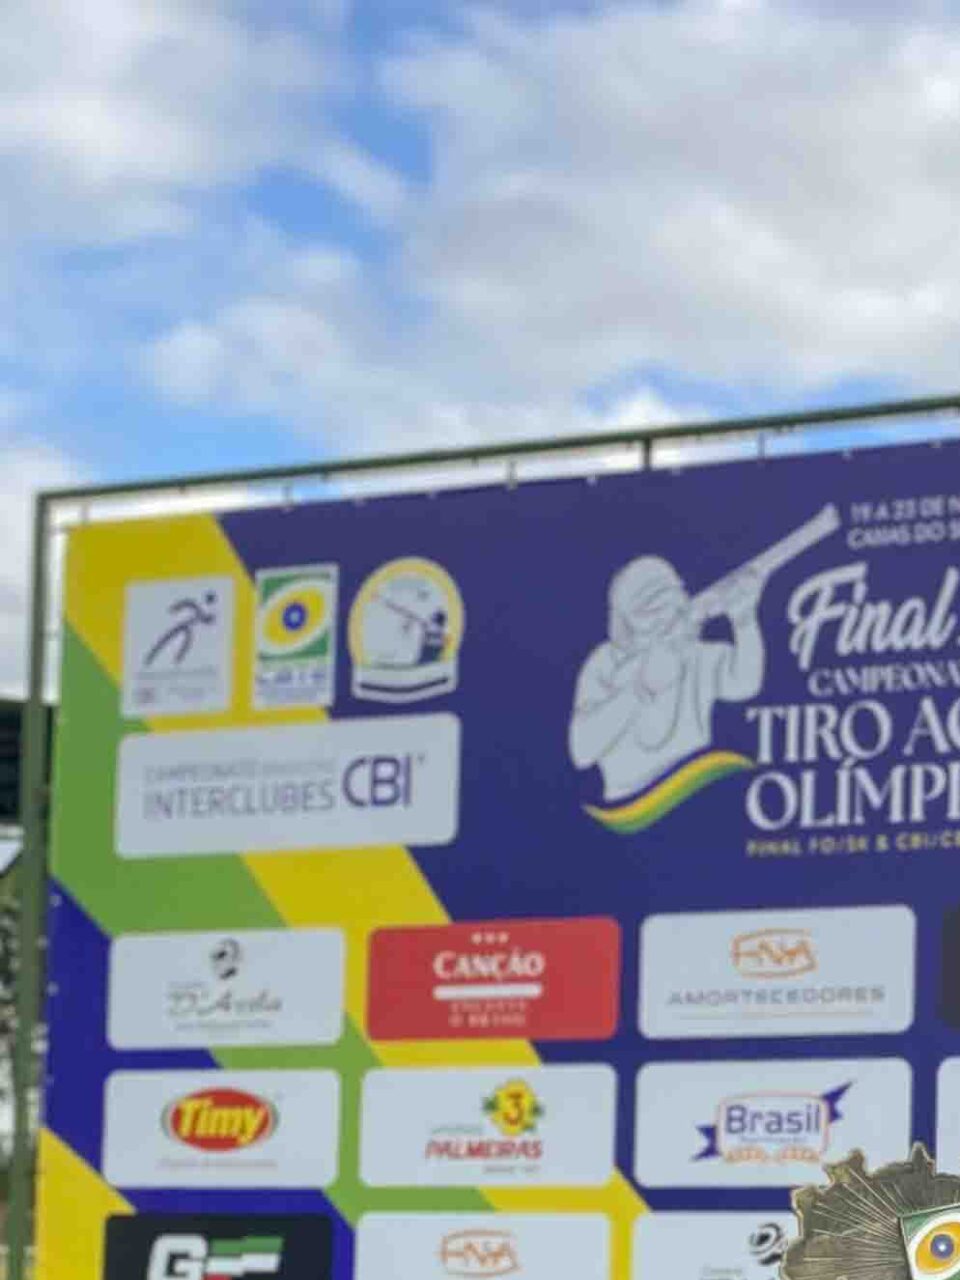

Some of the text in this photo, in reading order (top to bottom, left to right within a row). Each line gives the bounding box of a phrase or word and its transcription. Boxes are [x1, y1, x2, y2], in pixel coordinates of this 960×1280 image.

[919, 495, 943, 517] DE
[913, 519, 945, 543] DO
[787, 561, 960, 671] Final
[745, 699, 893, 764] TIRO
[142, 777, 336, 820] INTERCLUBES
[667, 984, 887, 1006] AMORTECEDORES
[175, 1096, 270, 1150] Timy
[502, 1092, 525, 1127] 3
[726, 1103, 820, 1136] Brasil
[424, 1139, 543, 1161] PALMEIRAS
